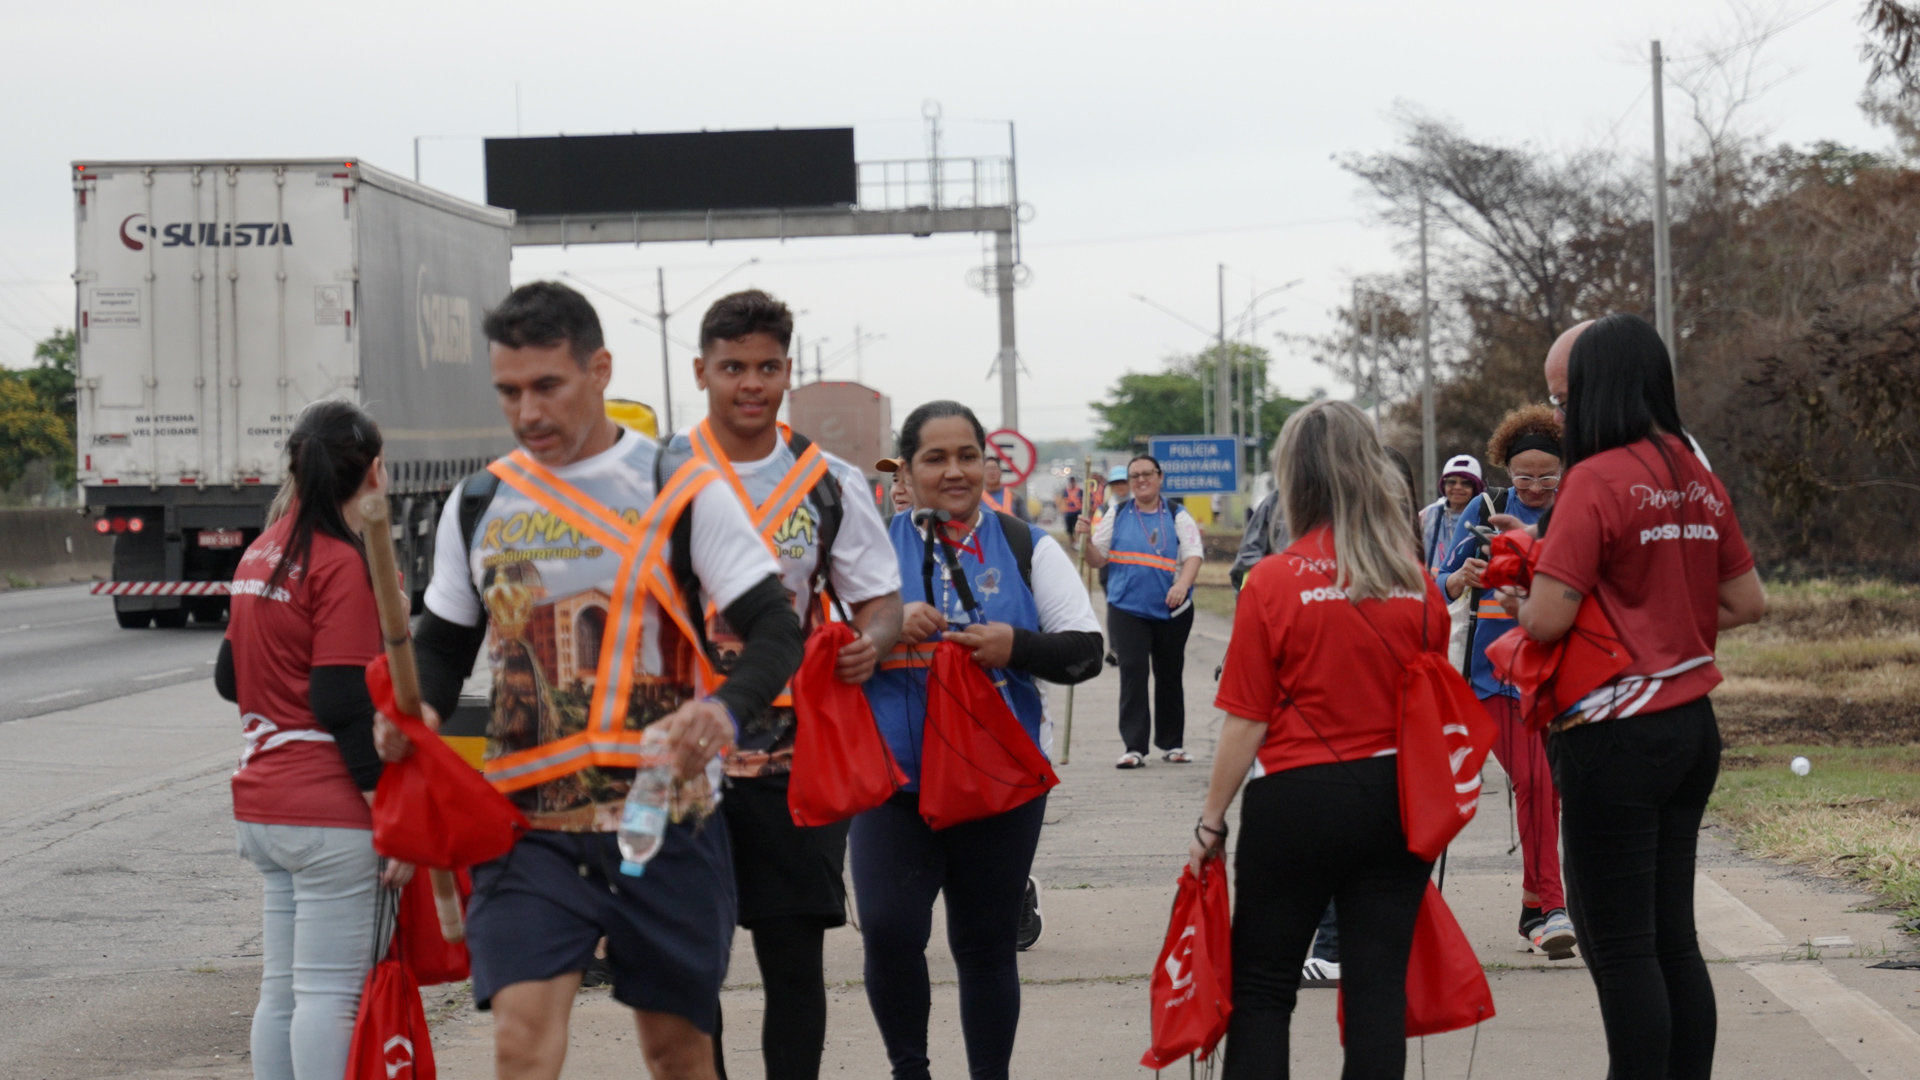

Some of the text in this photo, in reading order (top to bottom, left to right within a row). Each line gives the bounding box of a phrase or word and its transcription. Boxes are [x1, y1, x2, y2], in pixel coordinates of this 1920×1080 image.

[135, 415, 194, 423] MANTENHA
[132, 428, 199, 436] VELOCIDADE
[1169, 441, 1219, 458] POLÍCIA
[1166, 475, 1222, 489] FEDERAL
[481, 508, 641, 550] ROMAA
